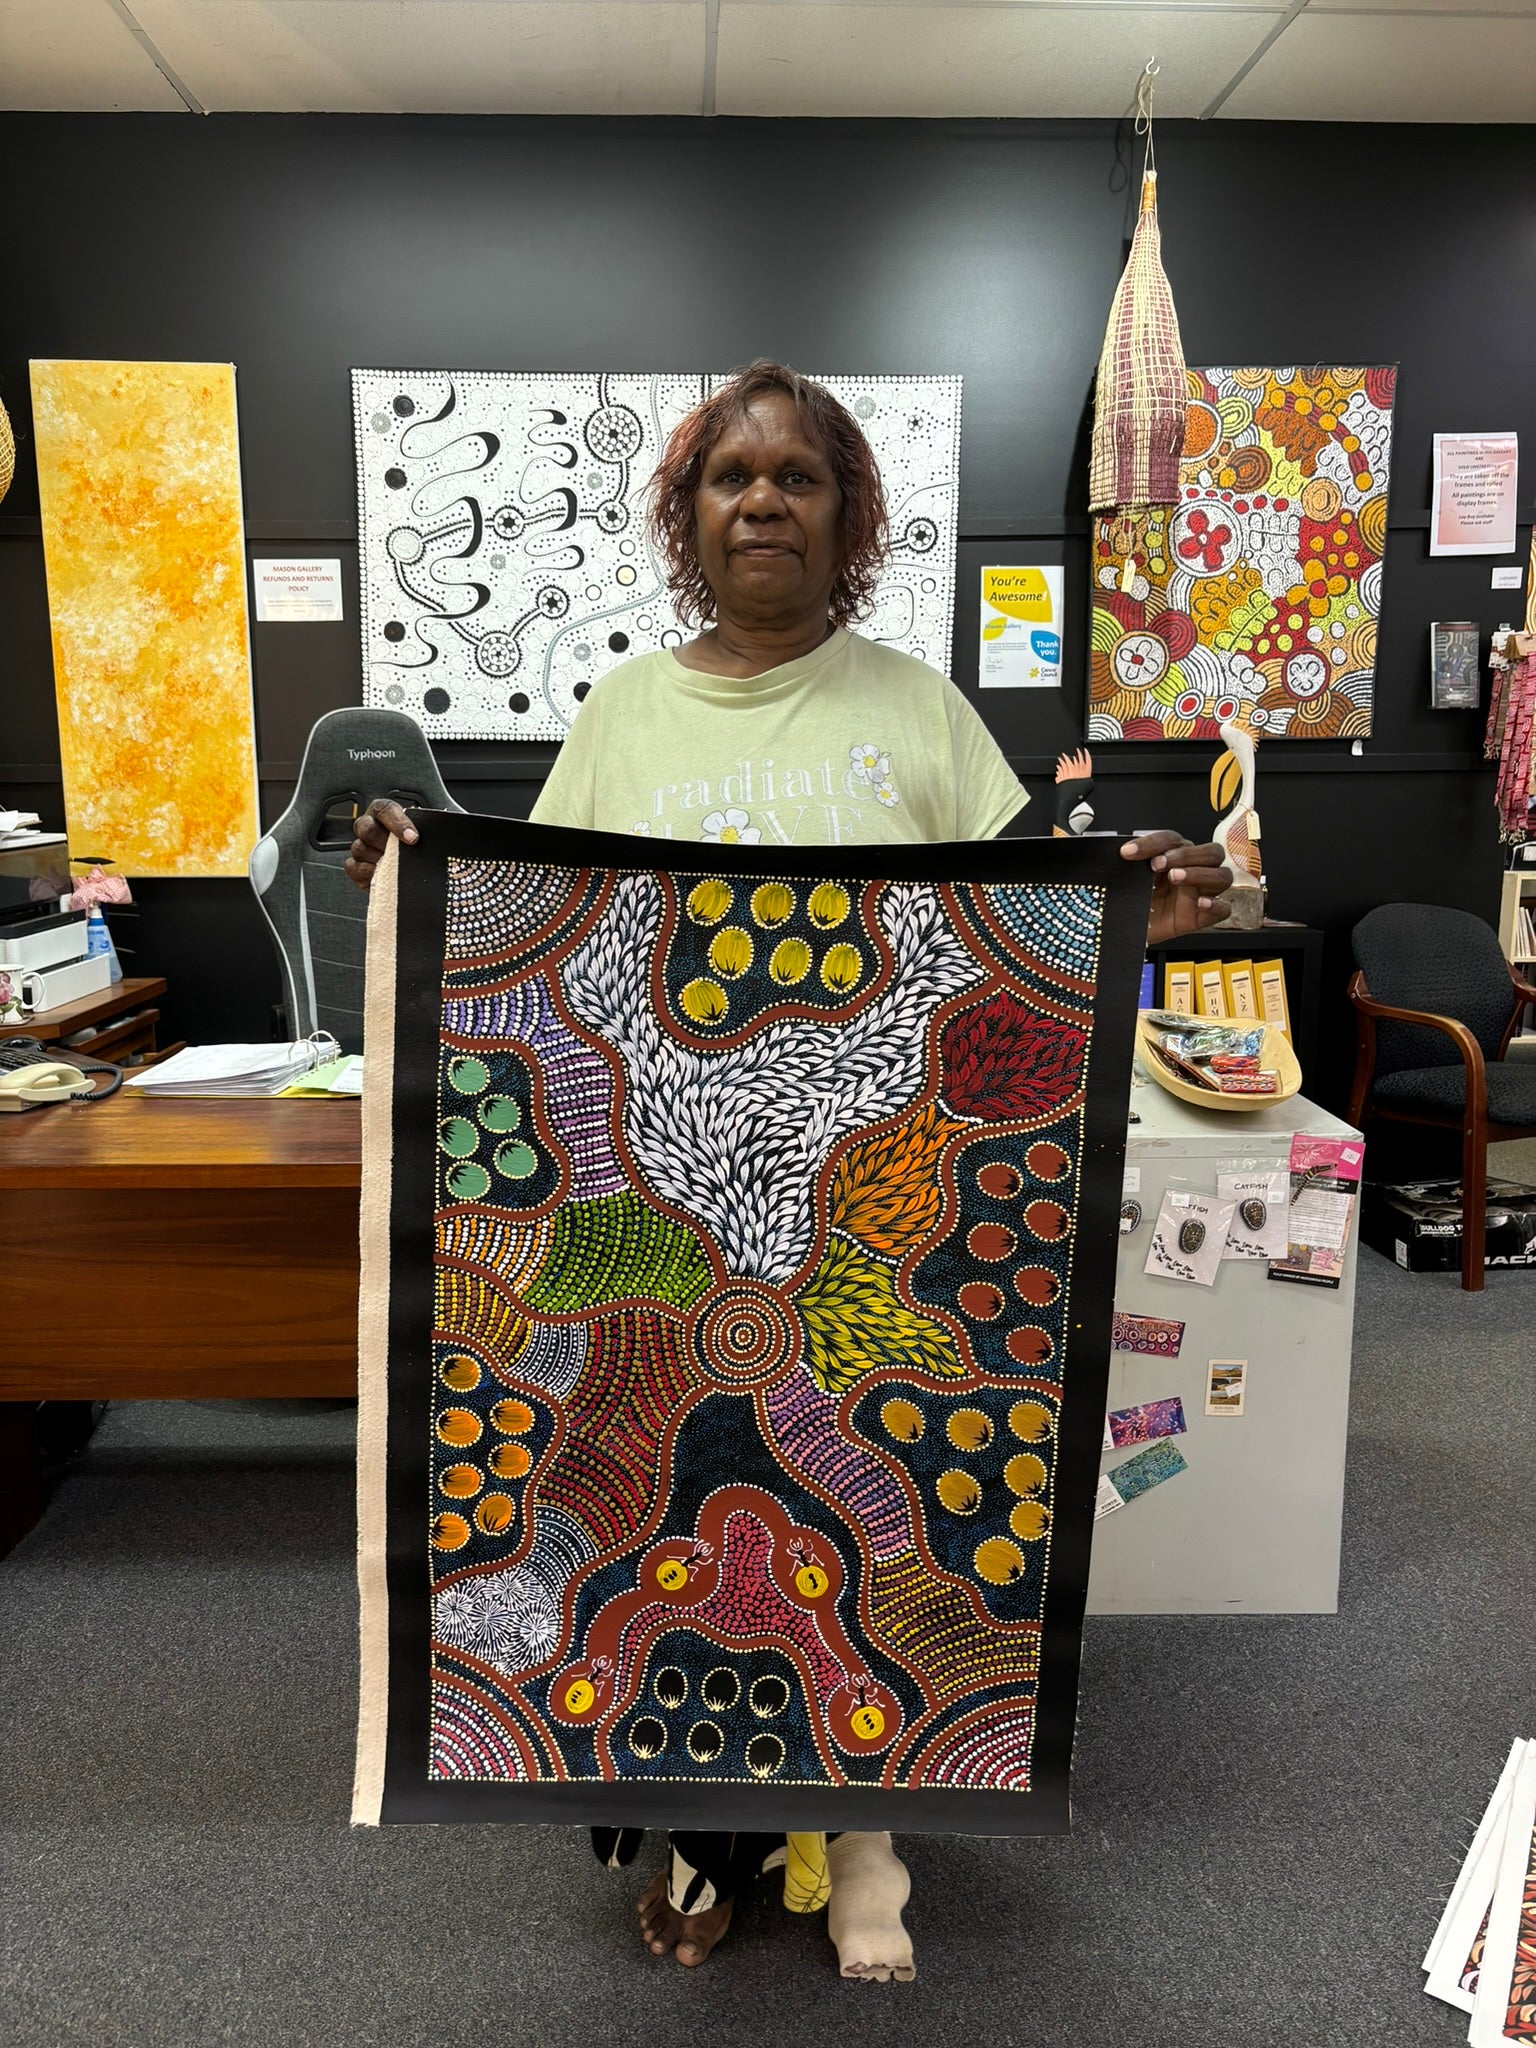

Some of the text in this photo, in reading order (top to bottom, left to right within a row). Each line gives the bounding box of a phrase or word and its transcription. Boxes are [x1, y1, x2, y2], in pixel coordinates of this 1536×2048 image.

[990, 575, 1027, 586] You're
[1036, 640, 1059, 648] Thank
[346, 748, 396, 761] Typhoon
[651, 757, 872, 818] radiate
[1183, 1203, 1209, 1214] TFISH
[1419, 1224, 1455, 1232] BULLDOG
